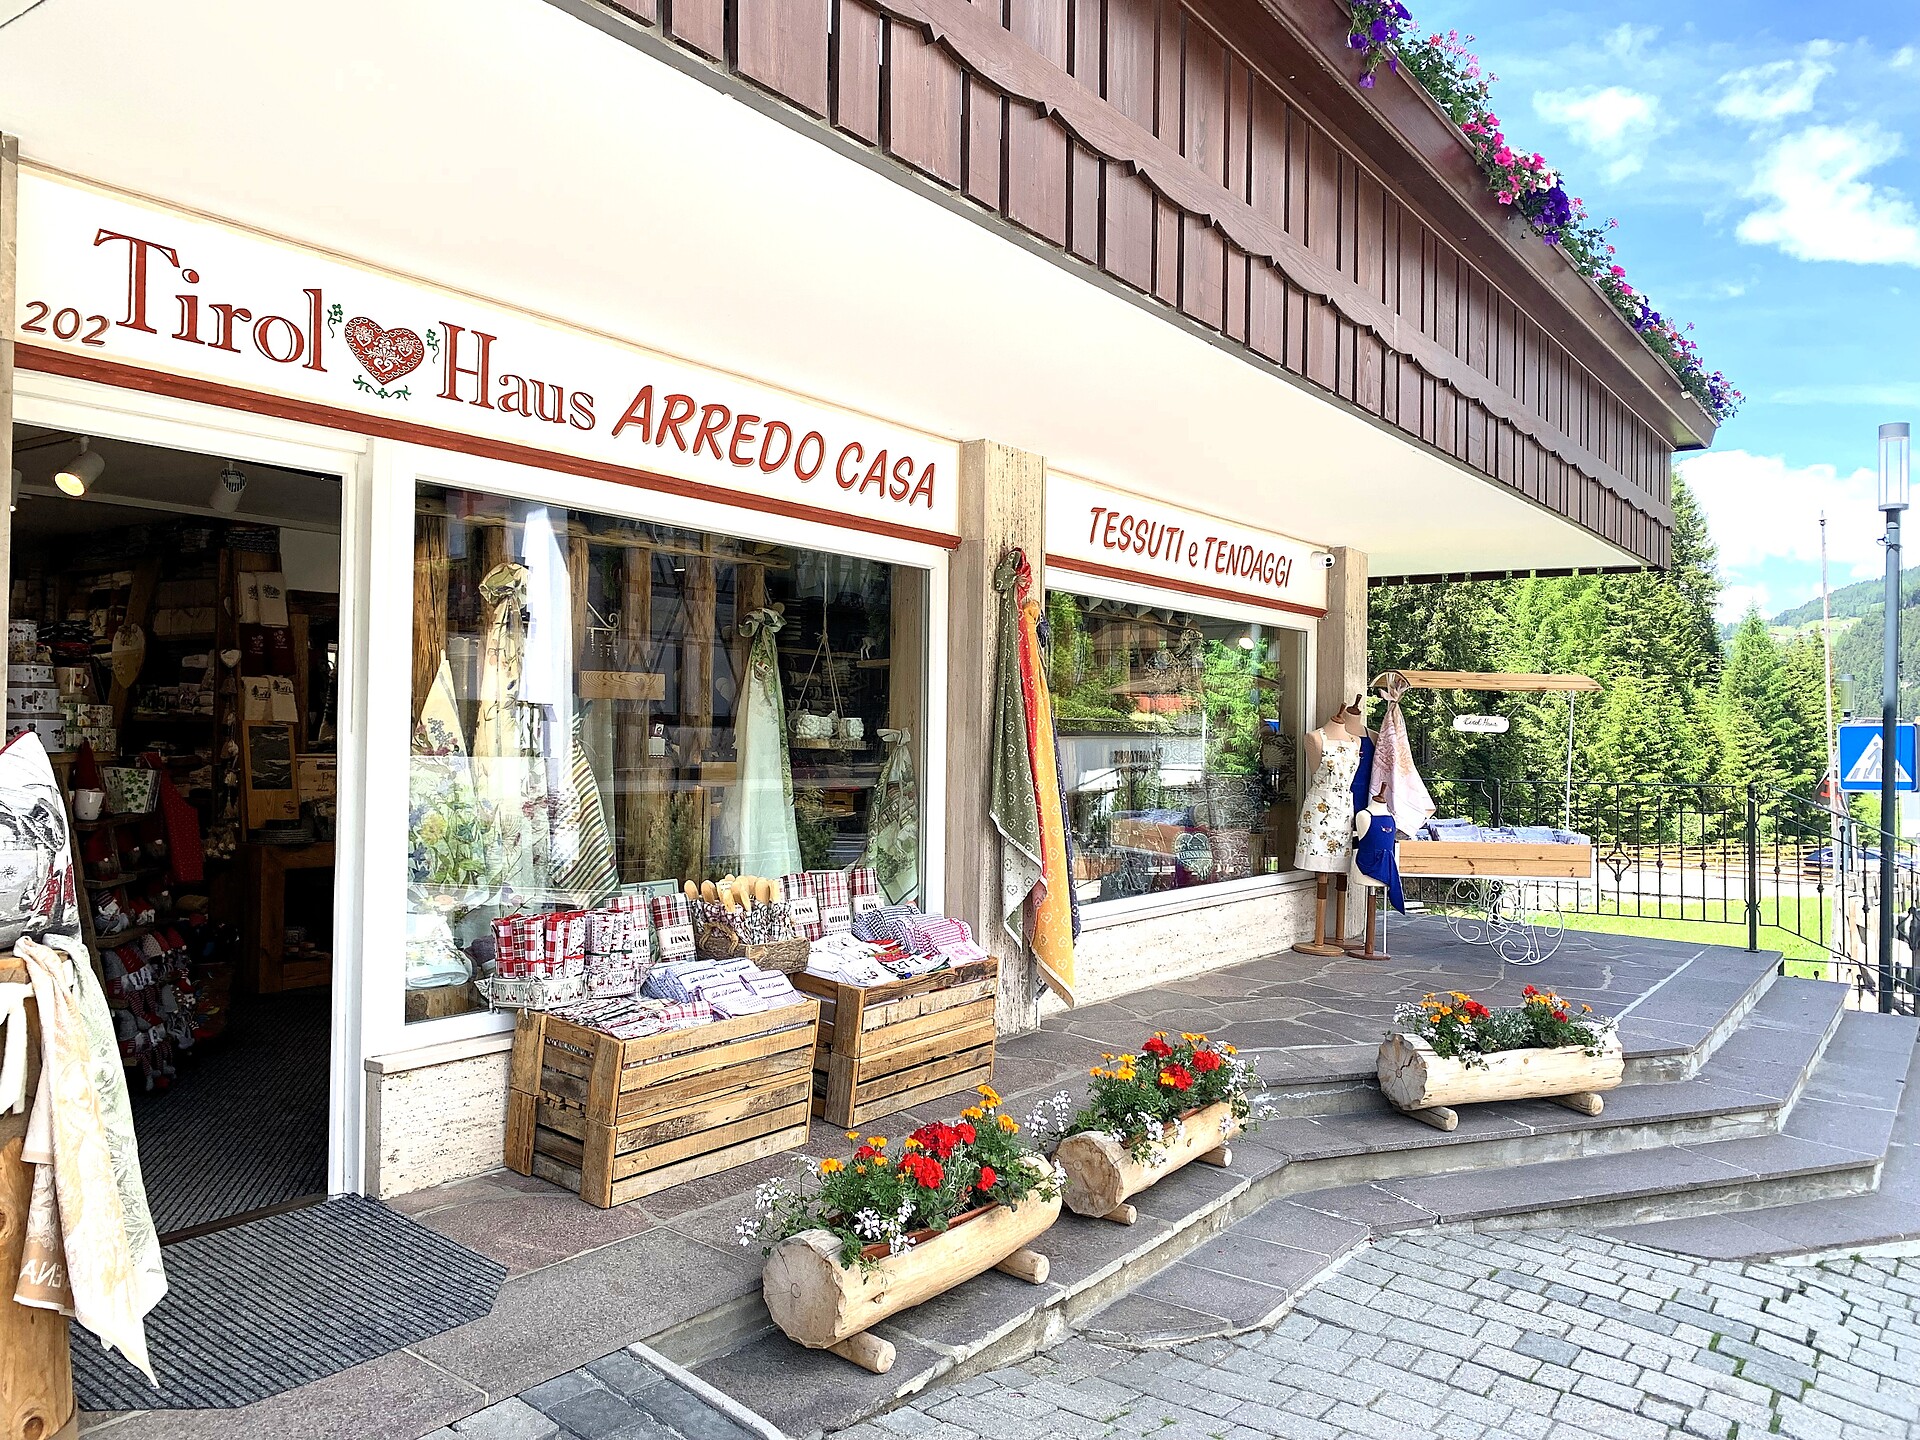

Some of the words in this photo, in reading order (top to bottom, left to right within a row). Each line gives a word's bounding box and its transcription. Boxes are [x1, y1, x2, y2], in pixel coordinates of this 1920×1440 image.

[20, 300, 110, 347] 202
[93, 229, 328, 373] Tirol
[437, 321, 596, 431] Haus
[611, 385, 826, 483] ARREDO
[835, 441, 936, 509] CASA
[1089, 506, 1185, 564] TESSUTI
[1188, 541, 1198, 568] e
[1203, 536, 1293, 589] TENDAGGI
